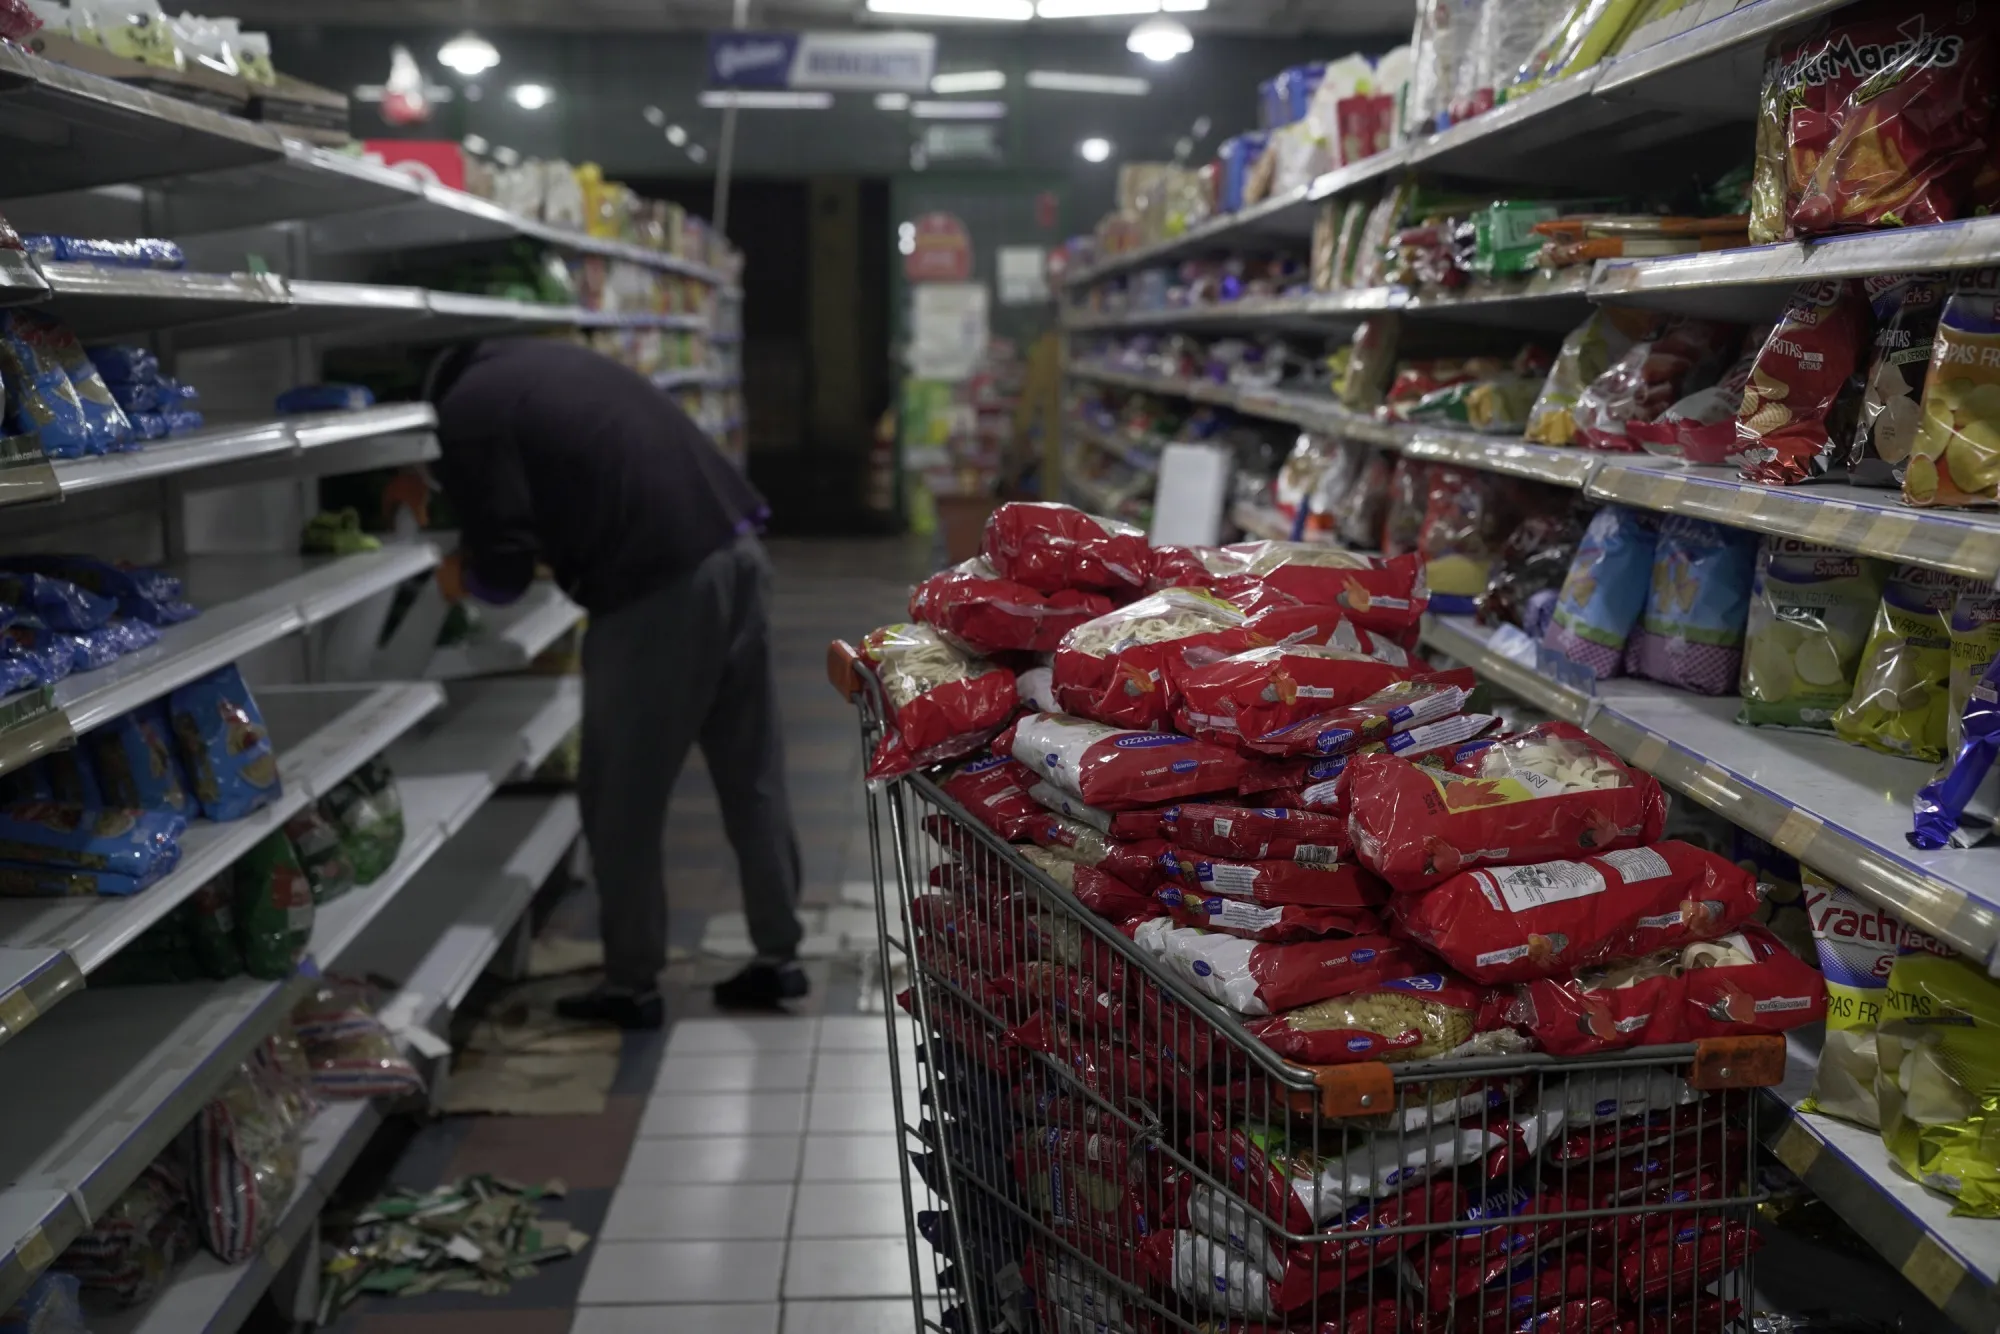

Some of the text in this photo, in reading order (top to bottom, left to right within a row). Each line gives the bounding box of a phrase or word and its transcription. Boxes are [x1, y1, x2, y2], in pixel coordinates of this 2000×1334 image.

[1813, 559, 1859, 577] Snacks
[1805, 591, 1843, 606] FRITAS
[1899, 617, 1938, 639] FRITAS
[1962, 642, 1987, 663] FRITAS
